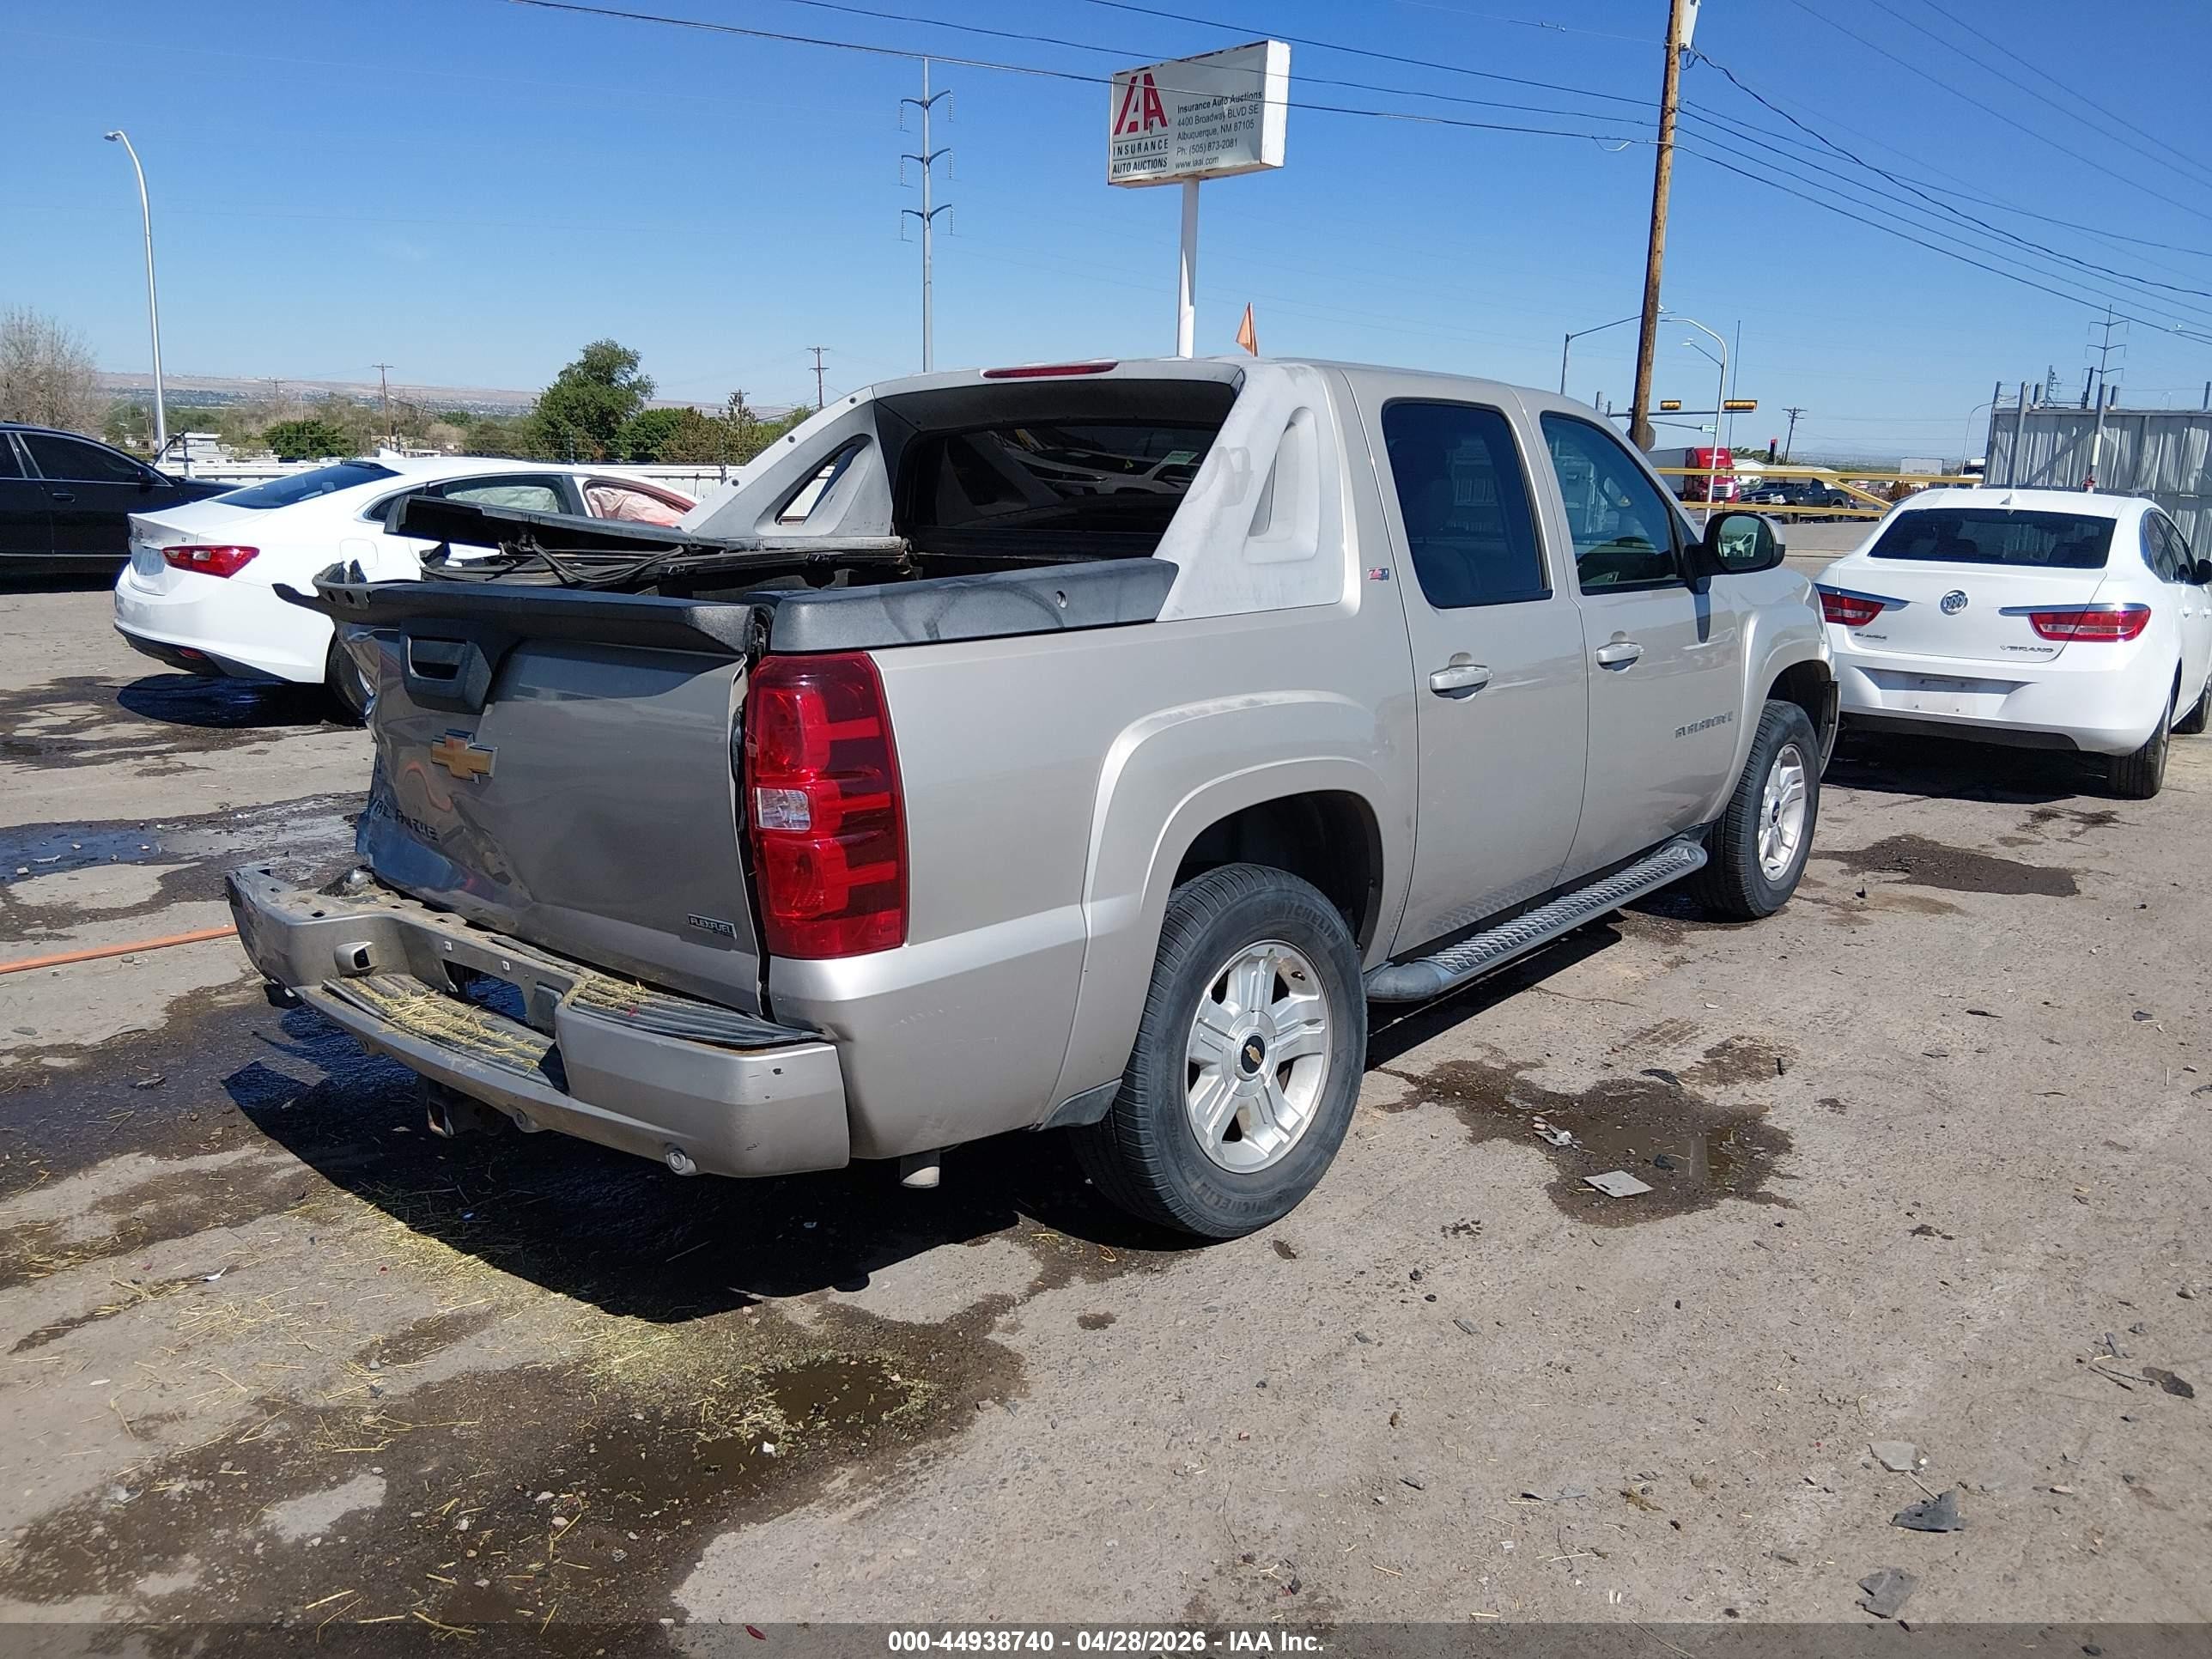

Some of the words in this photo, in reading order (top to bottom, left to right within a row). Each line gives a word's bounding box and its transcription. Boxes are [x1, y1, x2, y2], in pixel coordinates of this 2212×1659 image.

[1177, 100, 1211, 114] Insurance
[1212, 97, 1228, 106] Auto
[1230, 91, 1262, 103] Auctions
[1177, 117, 1194, 126] 4400
[1194, 112, 1225, 125] Broadway
[1227, 106, 1247, 118] BLVD
[1249, 104, 1259, 115] SE
[1176, 128, 1219, 141] Albuquerque,
[1220, 123, 1232, 134] NM
[1234, 118, 1255, 131] 87105
[1113, 139, 1169, 156] INSURANCE
[1189, 142, 1206, 155] (505)
[1207, 137, 1237, 151] 873-2081
[1113, 161, 1131, 174] AUTO
[1133, 157, 1168, 173] AUCTIONS
